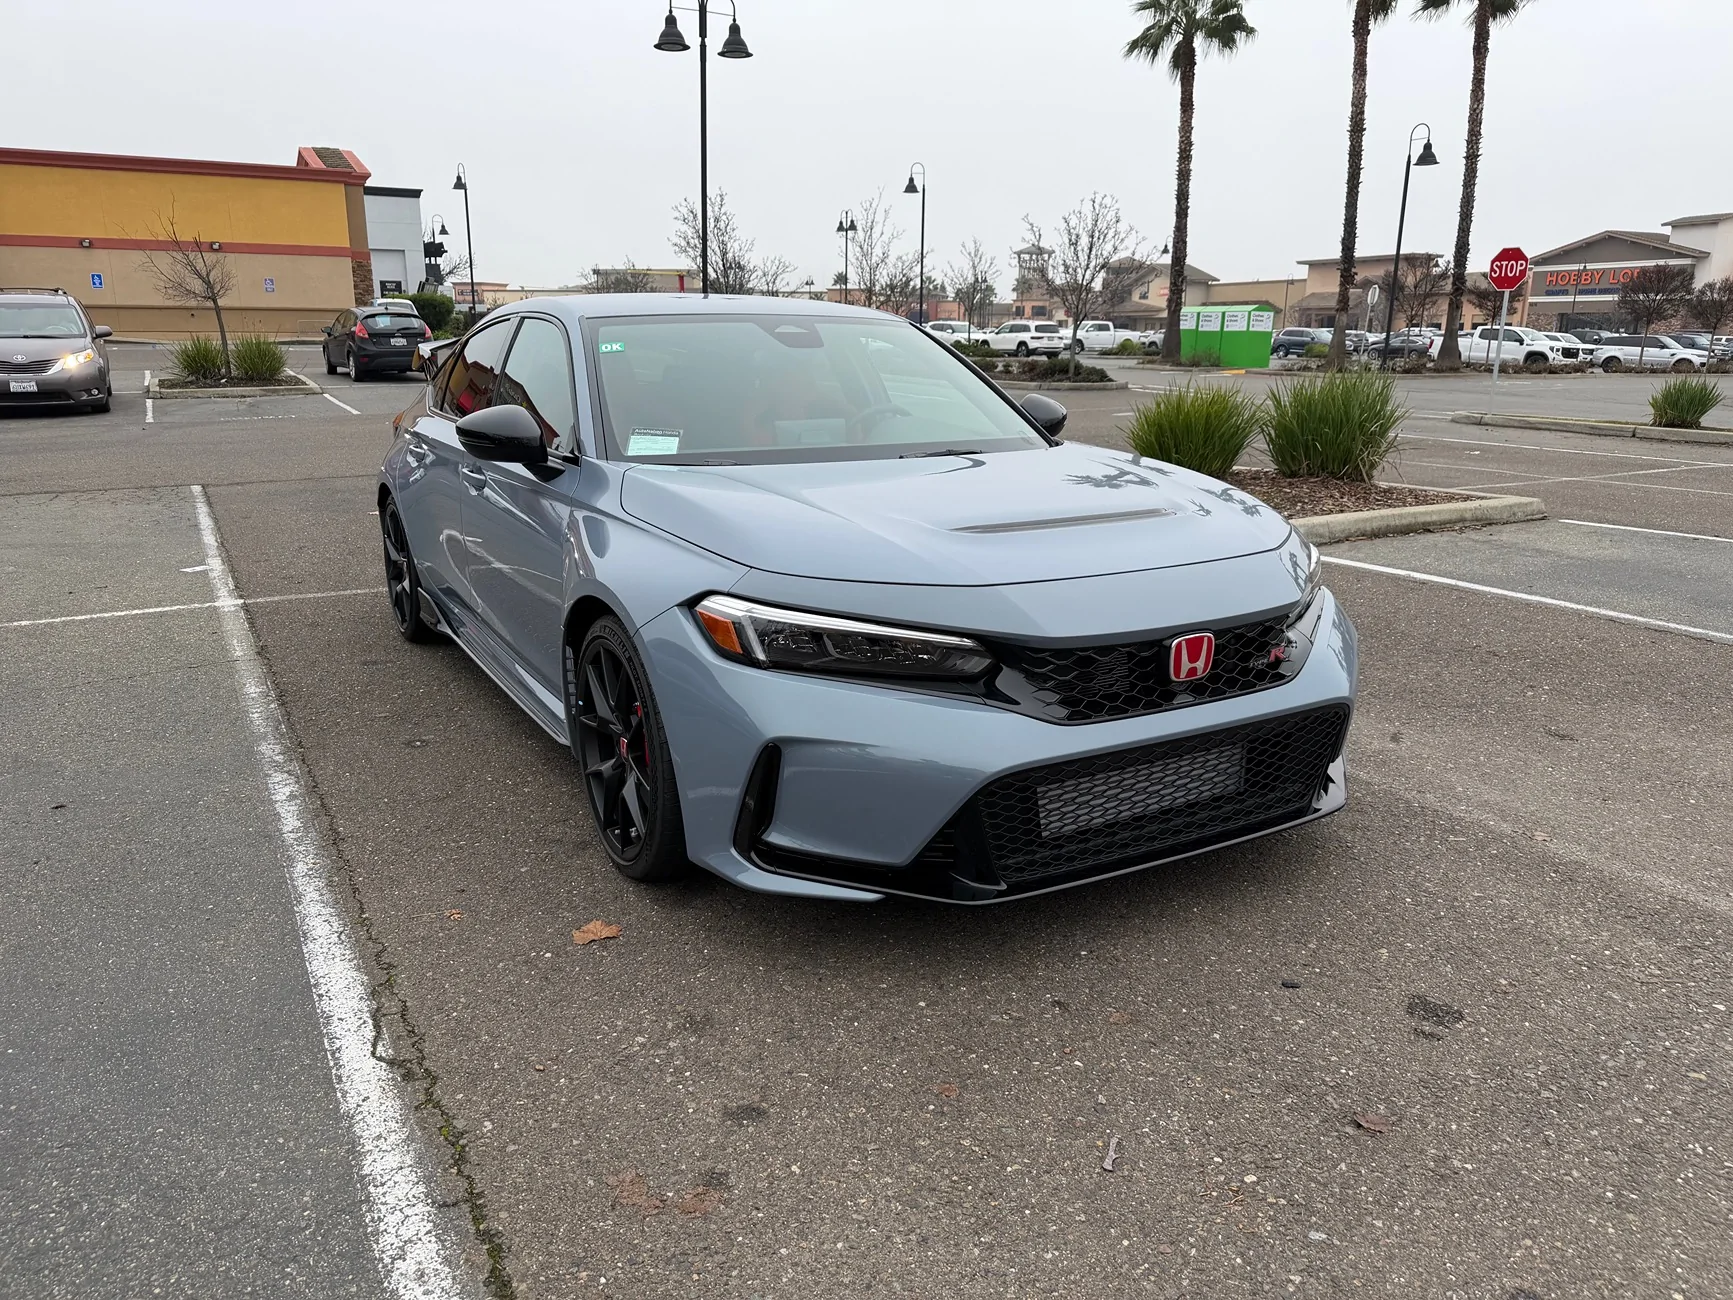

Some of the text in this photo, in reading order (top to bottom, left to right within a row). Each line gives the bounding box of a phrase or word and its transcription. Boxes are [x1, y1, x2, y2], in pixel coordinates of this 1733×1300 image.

[1491, 260, 1526, 278] STOP
[1545, 269, 1605, 286] HOBBY
[602, 343, 622, 351] OK
[604, 626, 630, 659] MICHELIN
